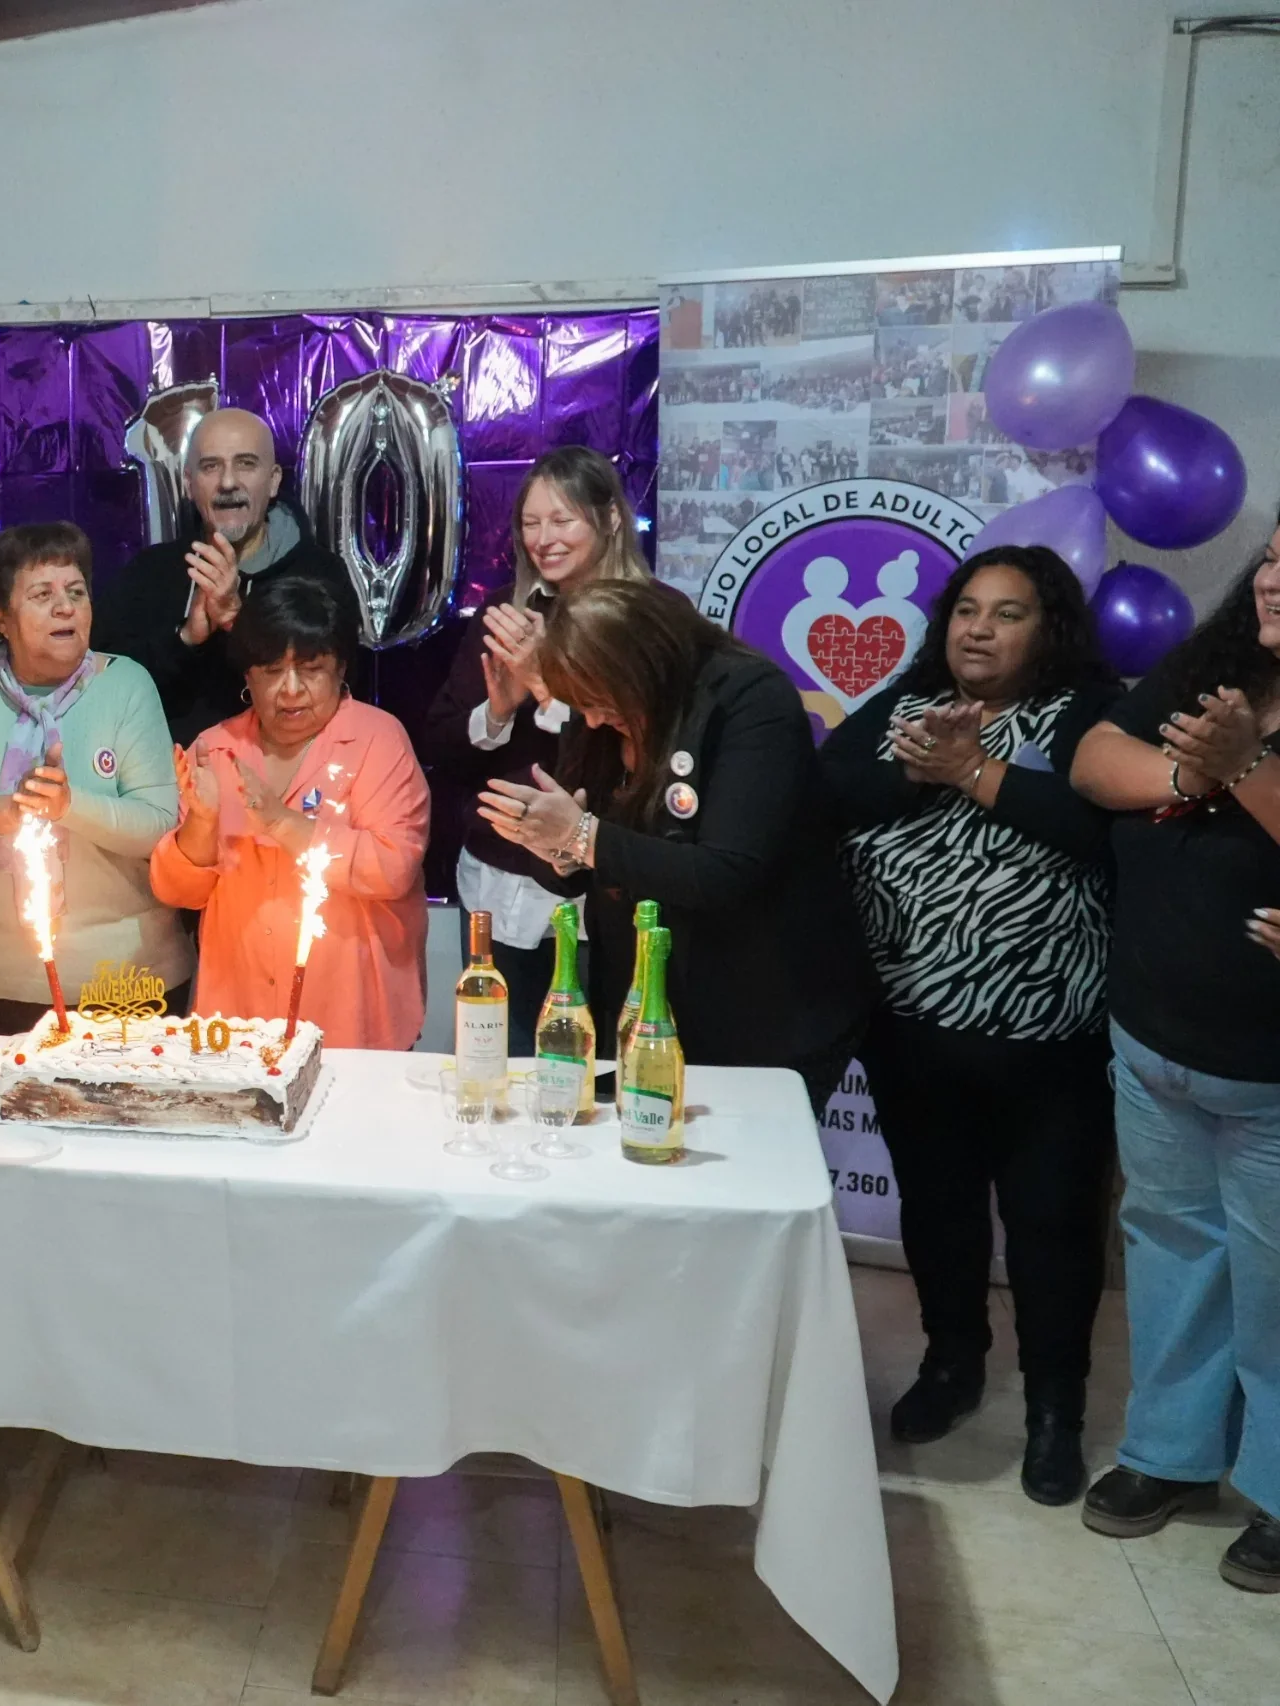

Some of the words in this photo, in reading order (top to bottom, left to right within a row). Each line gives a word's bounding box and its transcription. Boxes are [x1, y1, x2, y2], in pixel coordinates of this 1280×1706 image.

[707, 571, 736, 620] EJO
[731, 502, 815, 568] LOCAL
[823, 490, 858, 513] DE
[80, 974, 166, 1003] ANIVERSARIO
[184, 1019, 230, 1054] 10
[634, 1110, 664, 1125] Valle
[828, 1168, 889, 1196] 7.360
